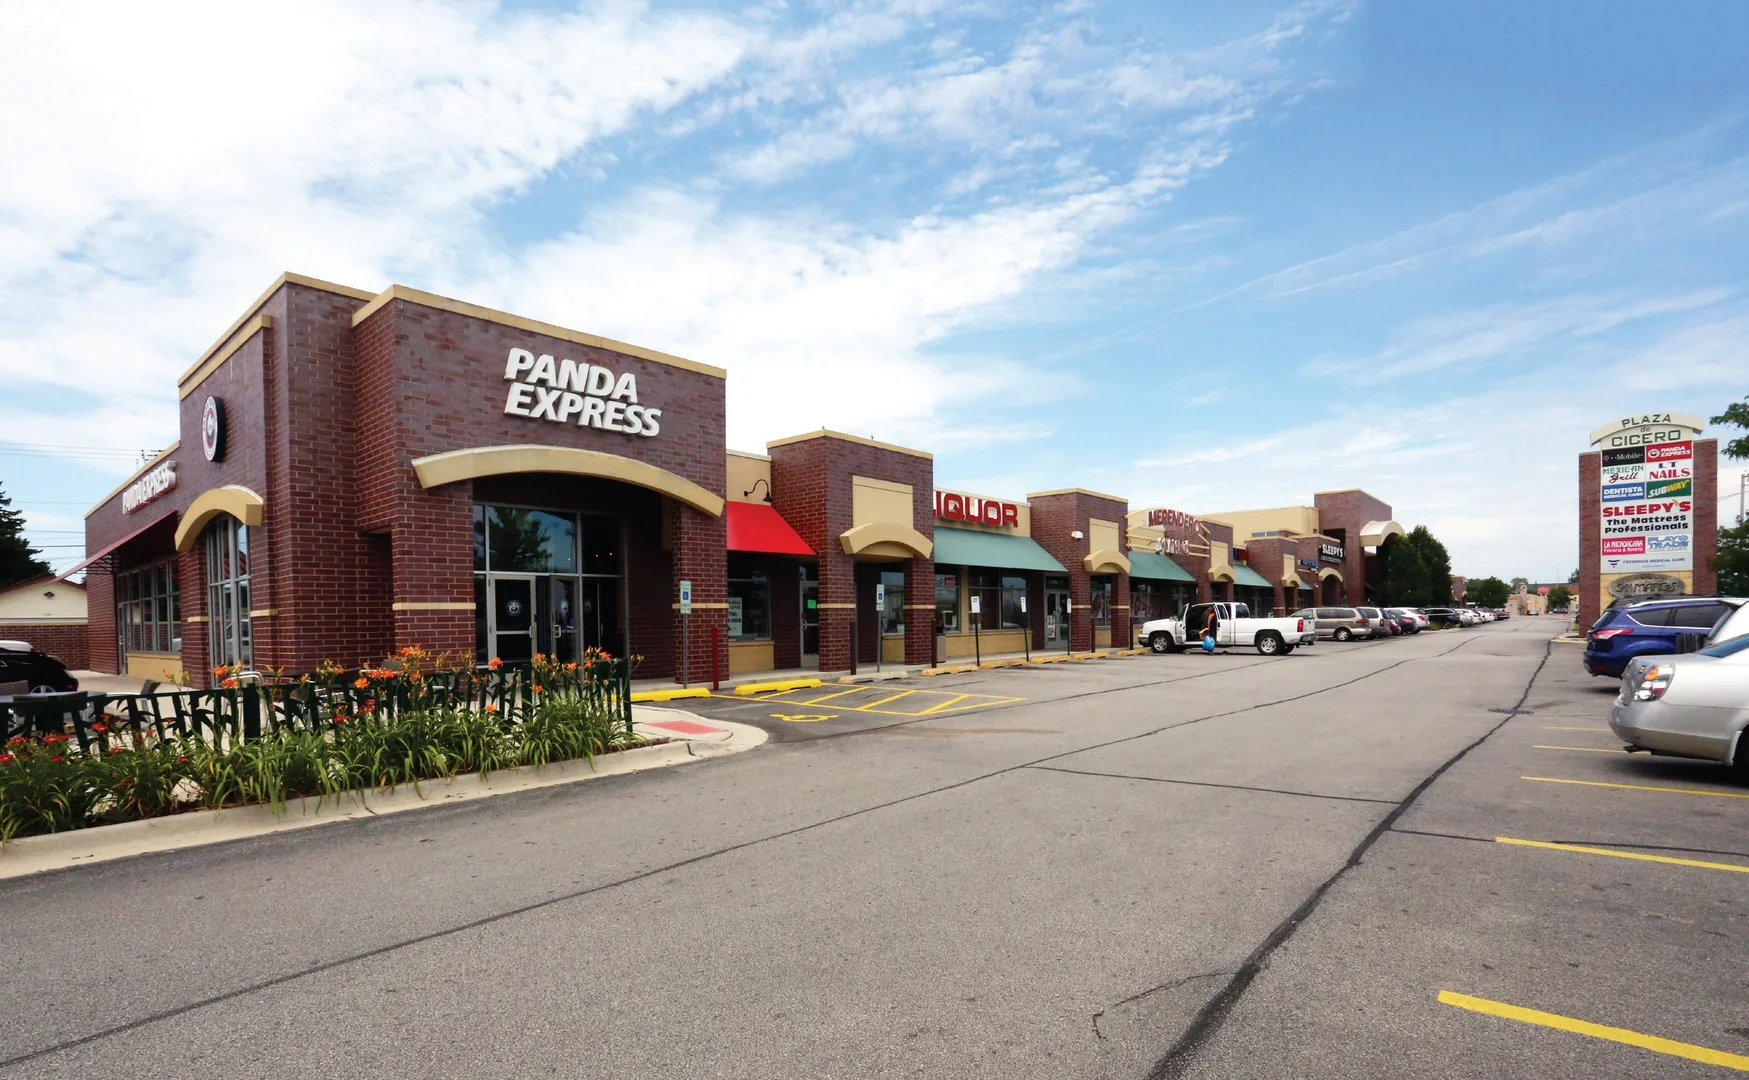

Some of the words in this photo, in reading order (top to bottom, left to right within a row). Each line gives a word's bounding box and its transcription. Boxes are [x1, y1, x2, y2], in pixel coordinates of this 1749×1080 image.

[503, 347, 638, 404] PANDA
[504, 382, 662, 437] EXPRESS
[1622, 414, 1671, 427] PLAZA
[1612, 430, 1681, 447] CICERO
[1661, 446, 1685, 454] PANDA
[1603, 465, 1644, 475] MEXICAN
[1649, 468, 1691, 479] NAILS
[1609, 472, 1638, 483] Grill
[1604, 486, 1643, 495] DENTISTA
[1648, 480, 1690, 498] SUBWAY
[1603, 501, 1691, 517] SLEEPY'S
[1632, 515, 1686, 524] Mattress
[1605, 523, 1688, 533] Professionals
